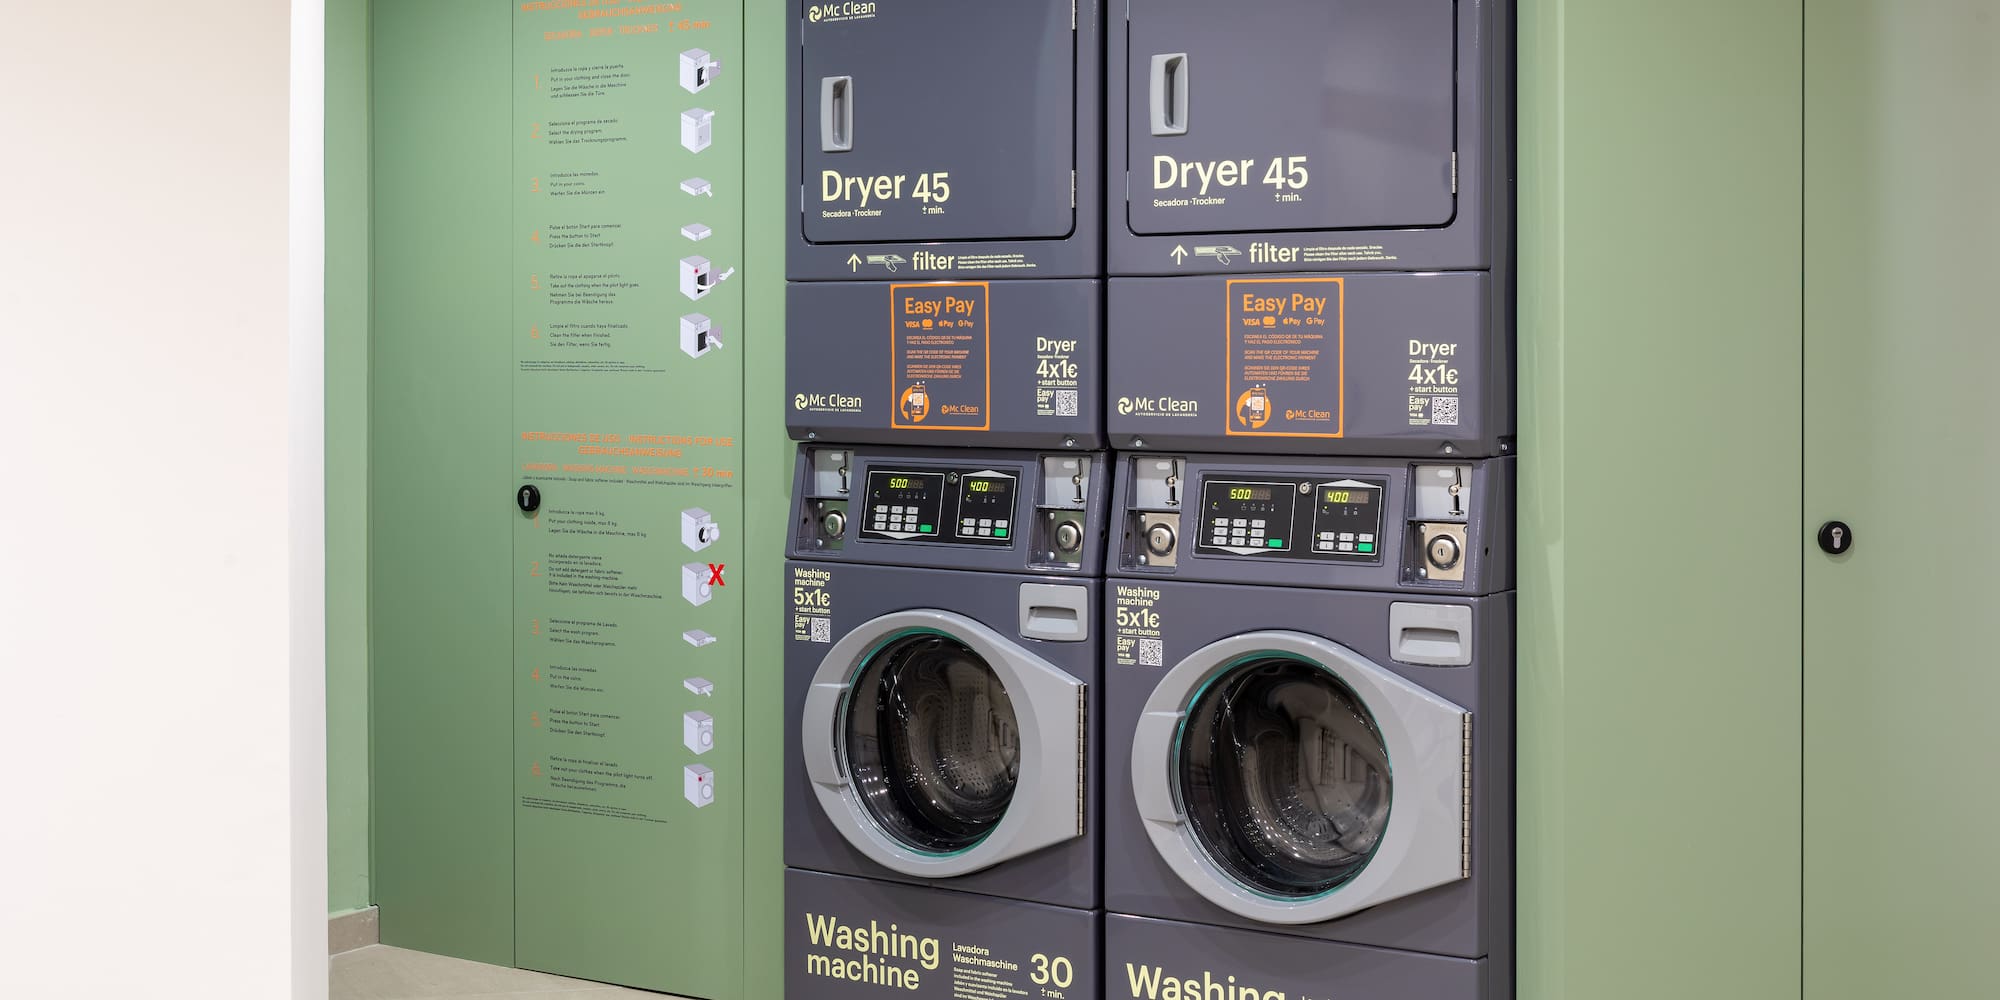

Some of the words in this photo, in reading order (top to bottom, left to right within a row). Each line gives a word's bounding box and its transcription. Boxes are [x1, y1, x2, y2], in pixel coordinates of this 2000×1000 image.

[824, 4, 840, 17] Mc
[843, 1, 876, 15] Clean
[1153, 156, 1254, 195] Dryer
[1262, 156, 1309, 190] 45
[822, 170, 906, 208] Dryer
[912, 172, 949, 203] 45
[1153, 197, 1188, 207] Secadora
[1282, 192, 1302, 202] min.
[822, 210, 851, 218] Secadora
[928, 206, 945, 215] min.
[1249, 242, 1299, 264] filter
[912, 252, 954, 271] filter
[905, 298, 942, 317] Easy
[946, 296, 975, 317] Pay
[1243, 294, 1287, 315] Easy
[1292, 293, 1326, 315] Pay
[1037, 337, 1077, 355] Dryer
[1409, 340, 1457, 359] Dryer
[1036, 360, 1078, 378] 4x1€
[1408, 364, 1458, 384] 4x1€
[809, 393, 826, 406] Mc
[829, 394, 861, 408] Clean
[1037, 388, 1054, 398] Easy
[1135, 397, 1155, 411] Mc
[1159, 397, 1198, 412] Clean
[1409, 396, 1430, 406] Easy
[960, 405, 979, 413] Clean
[1308, 409, 1330, 418] Clean
[795, 568, 830, 581] Washing
[795, 578, 825, 587] machine
[794, 587, 830, 606] 5x1€
[1117, 586, 1159, 600] Washing
[1117, 597, 1153, 606] machine
[795, 615, 810, 624] Easy
[1116, 607, 1160, 628] 5x1€
[1117, 637, 1135, 647] Easy
[806, 912, 940, 970] Washing
[952, 942, 989, 956] Lavadora
[807, 953, 920, 990] machine
[952, 953, 1018, 971] Waschmaschine
[1030, 953, 1073, 989] 30
[1047, 987, 1065, 1000] min.
